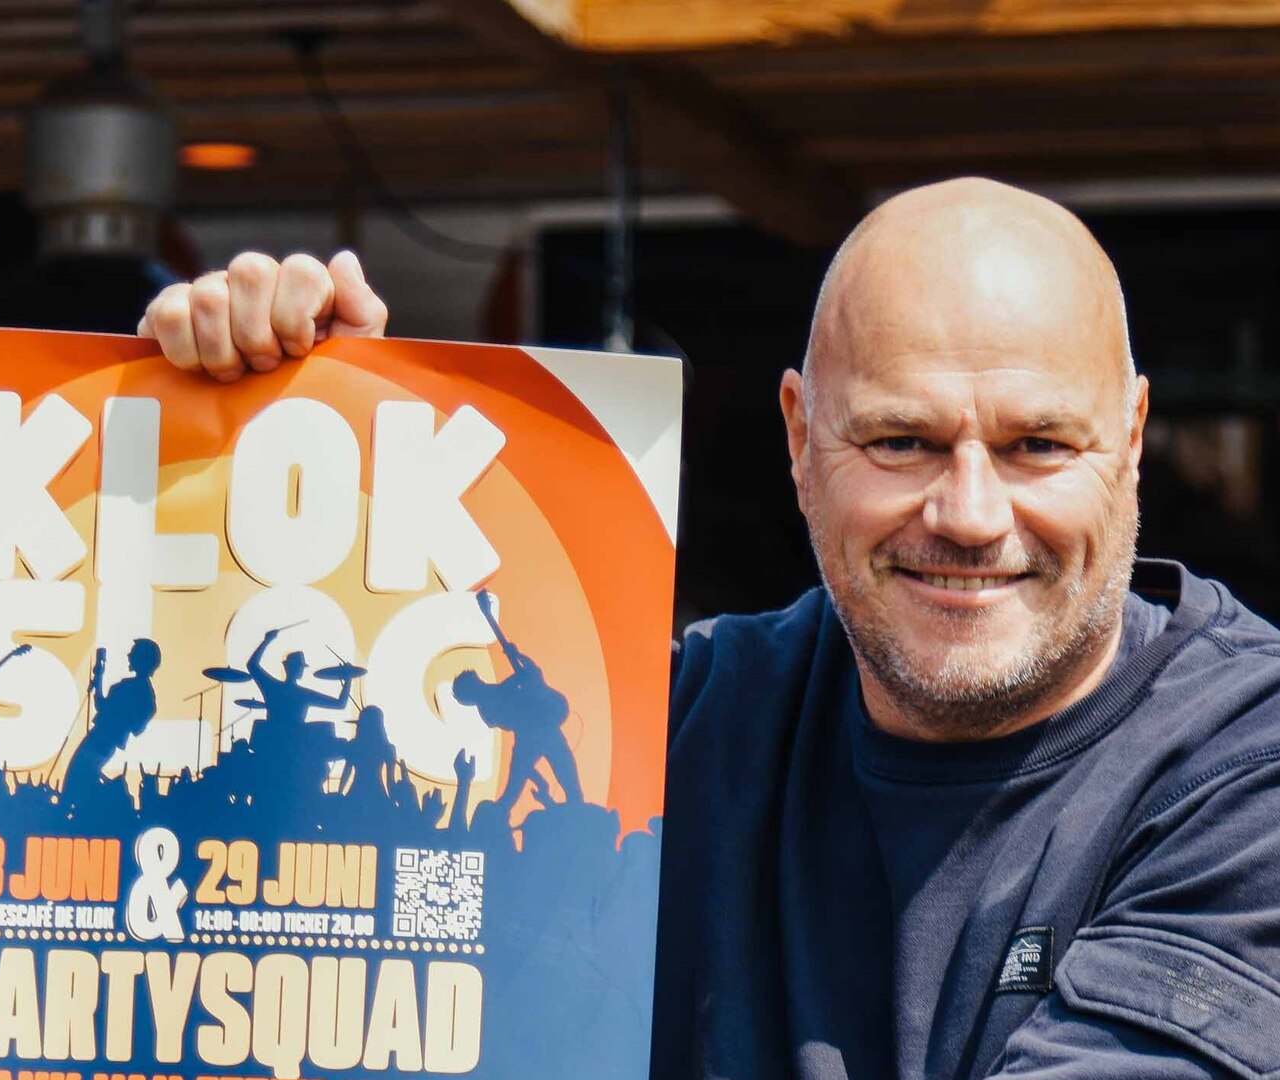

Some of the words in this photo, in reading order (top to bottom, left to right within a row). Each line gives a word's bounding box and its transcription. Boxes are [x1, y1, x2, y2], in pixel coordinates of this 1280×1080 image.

[9, 837, 120, 902] JUNI
[126, 826, 189, 942] &
[195, 839, 258, 905] 29
[263, 842, 377, 908] JUNI
[55, 905, 74, 928] DE
[284, 912, 330, 934] TICKET
